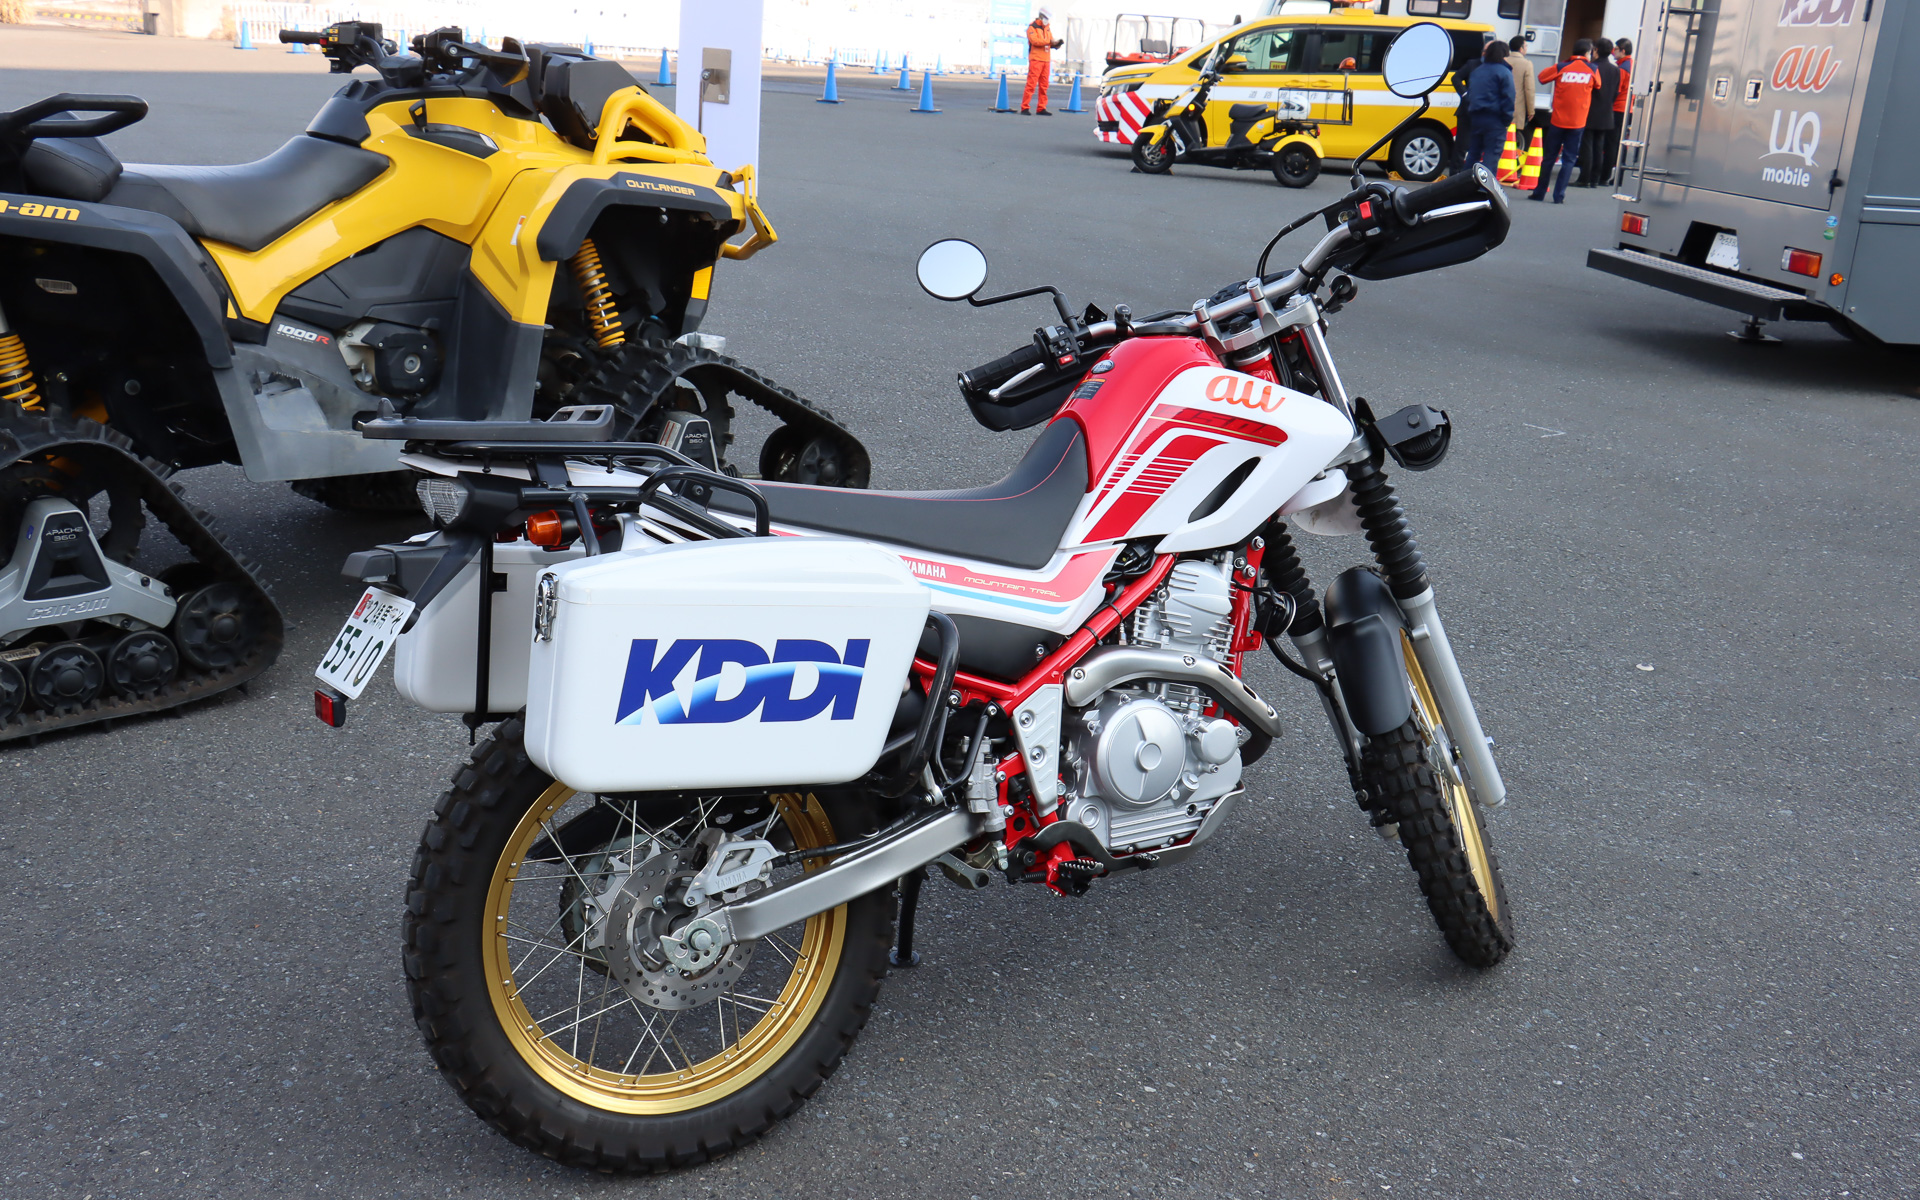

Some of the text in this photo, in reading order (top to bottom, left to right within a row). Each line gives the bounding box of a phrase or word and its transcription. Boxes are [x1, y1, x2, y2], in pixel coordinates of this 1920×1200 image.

[1560, 72, 1592, 85] KDDI
[1770, 45, 1842, 93] au
[1768, 109, 1821, 166] UQ
[1762, 166, 1811, 187] mobile
[625, 179, 697, 197] OUTLANDER
[277, 323, 330, 345] 1000R
[1205, 375, 1286, 413] au
[45, 526, 84, 537] APACHE
[53, 533, 77, 542] 360
[904, 559, 947, 579] YAMAHA
[322, 624, 384, 688] 55-10
[614, 638, 872, 726] KDDI
